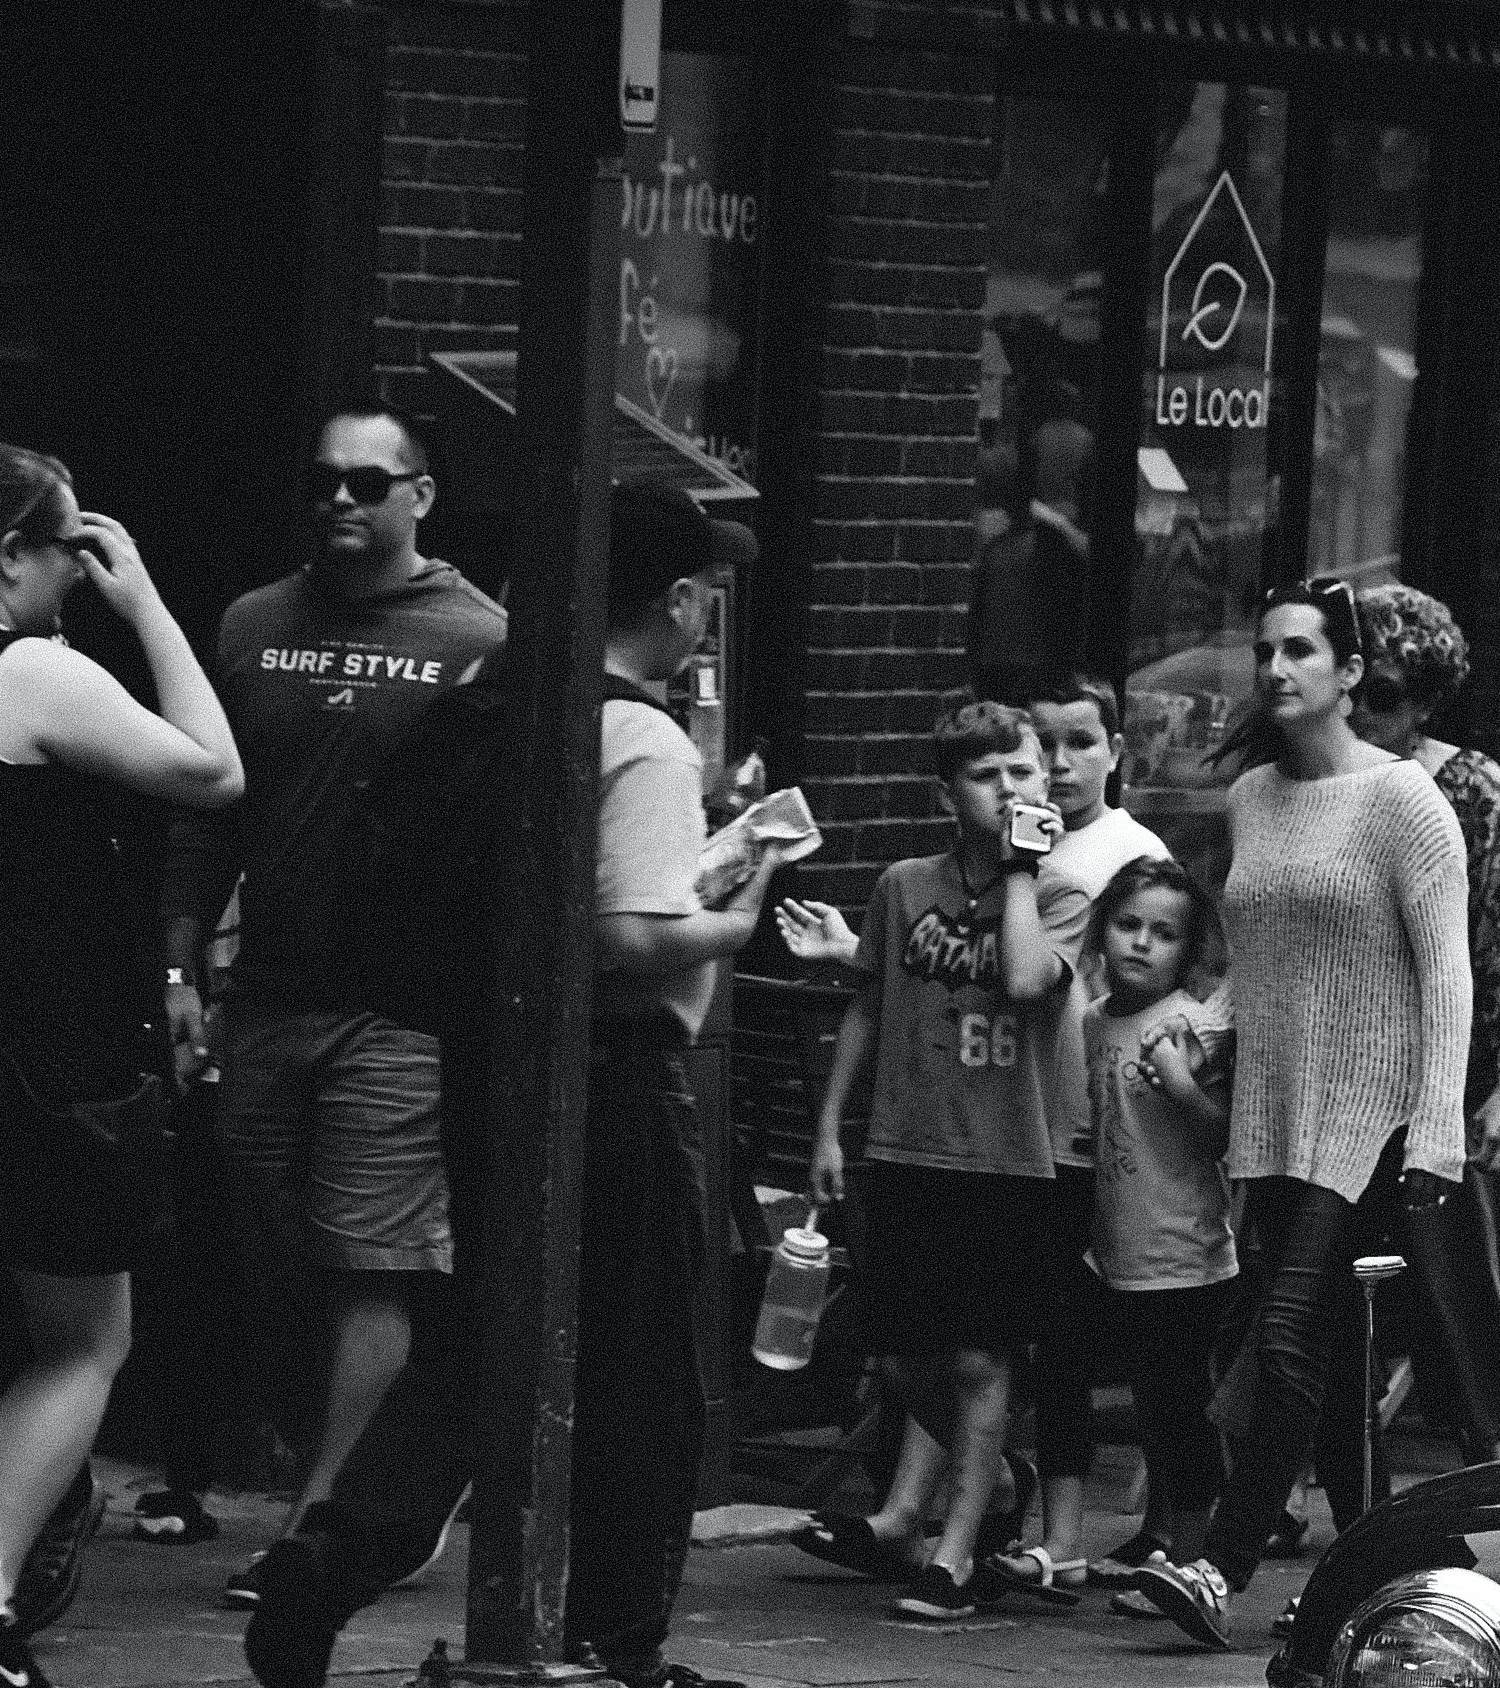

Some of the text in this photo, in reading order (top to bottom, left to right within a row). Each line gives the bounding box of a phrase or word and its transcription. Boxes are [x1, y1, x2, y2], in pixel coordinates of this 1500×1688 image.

[1156, 375, 1188, 426] Le
[260, 647, 336, 674] SURF
[343, 652, 444, 685] STYLE
[903, 912, 999, 982] BATMA
[959, 1012, 1018, 1068] 66
